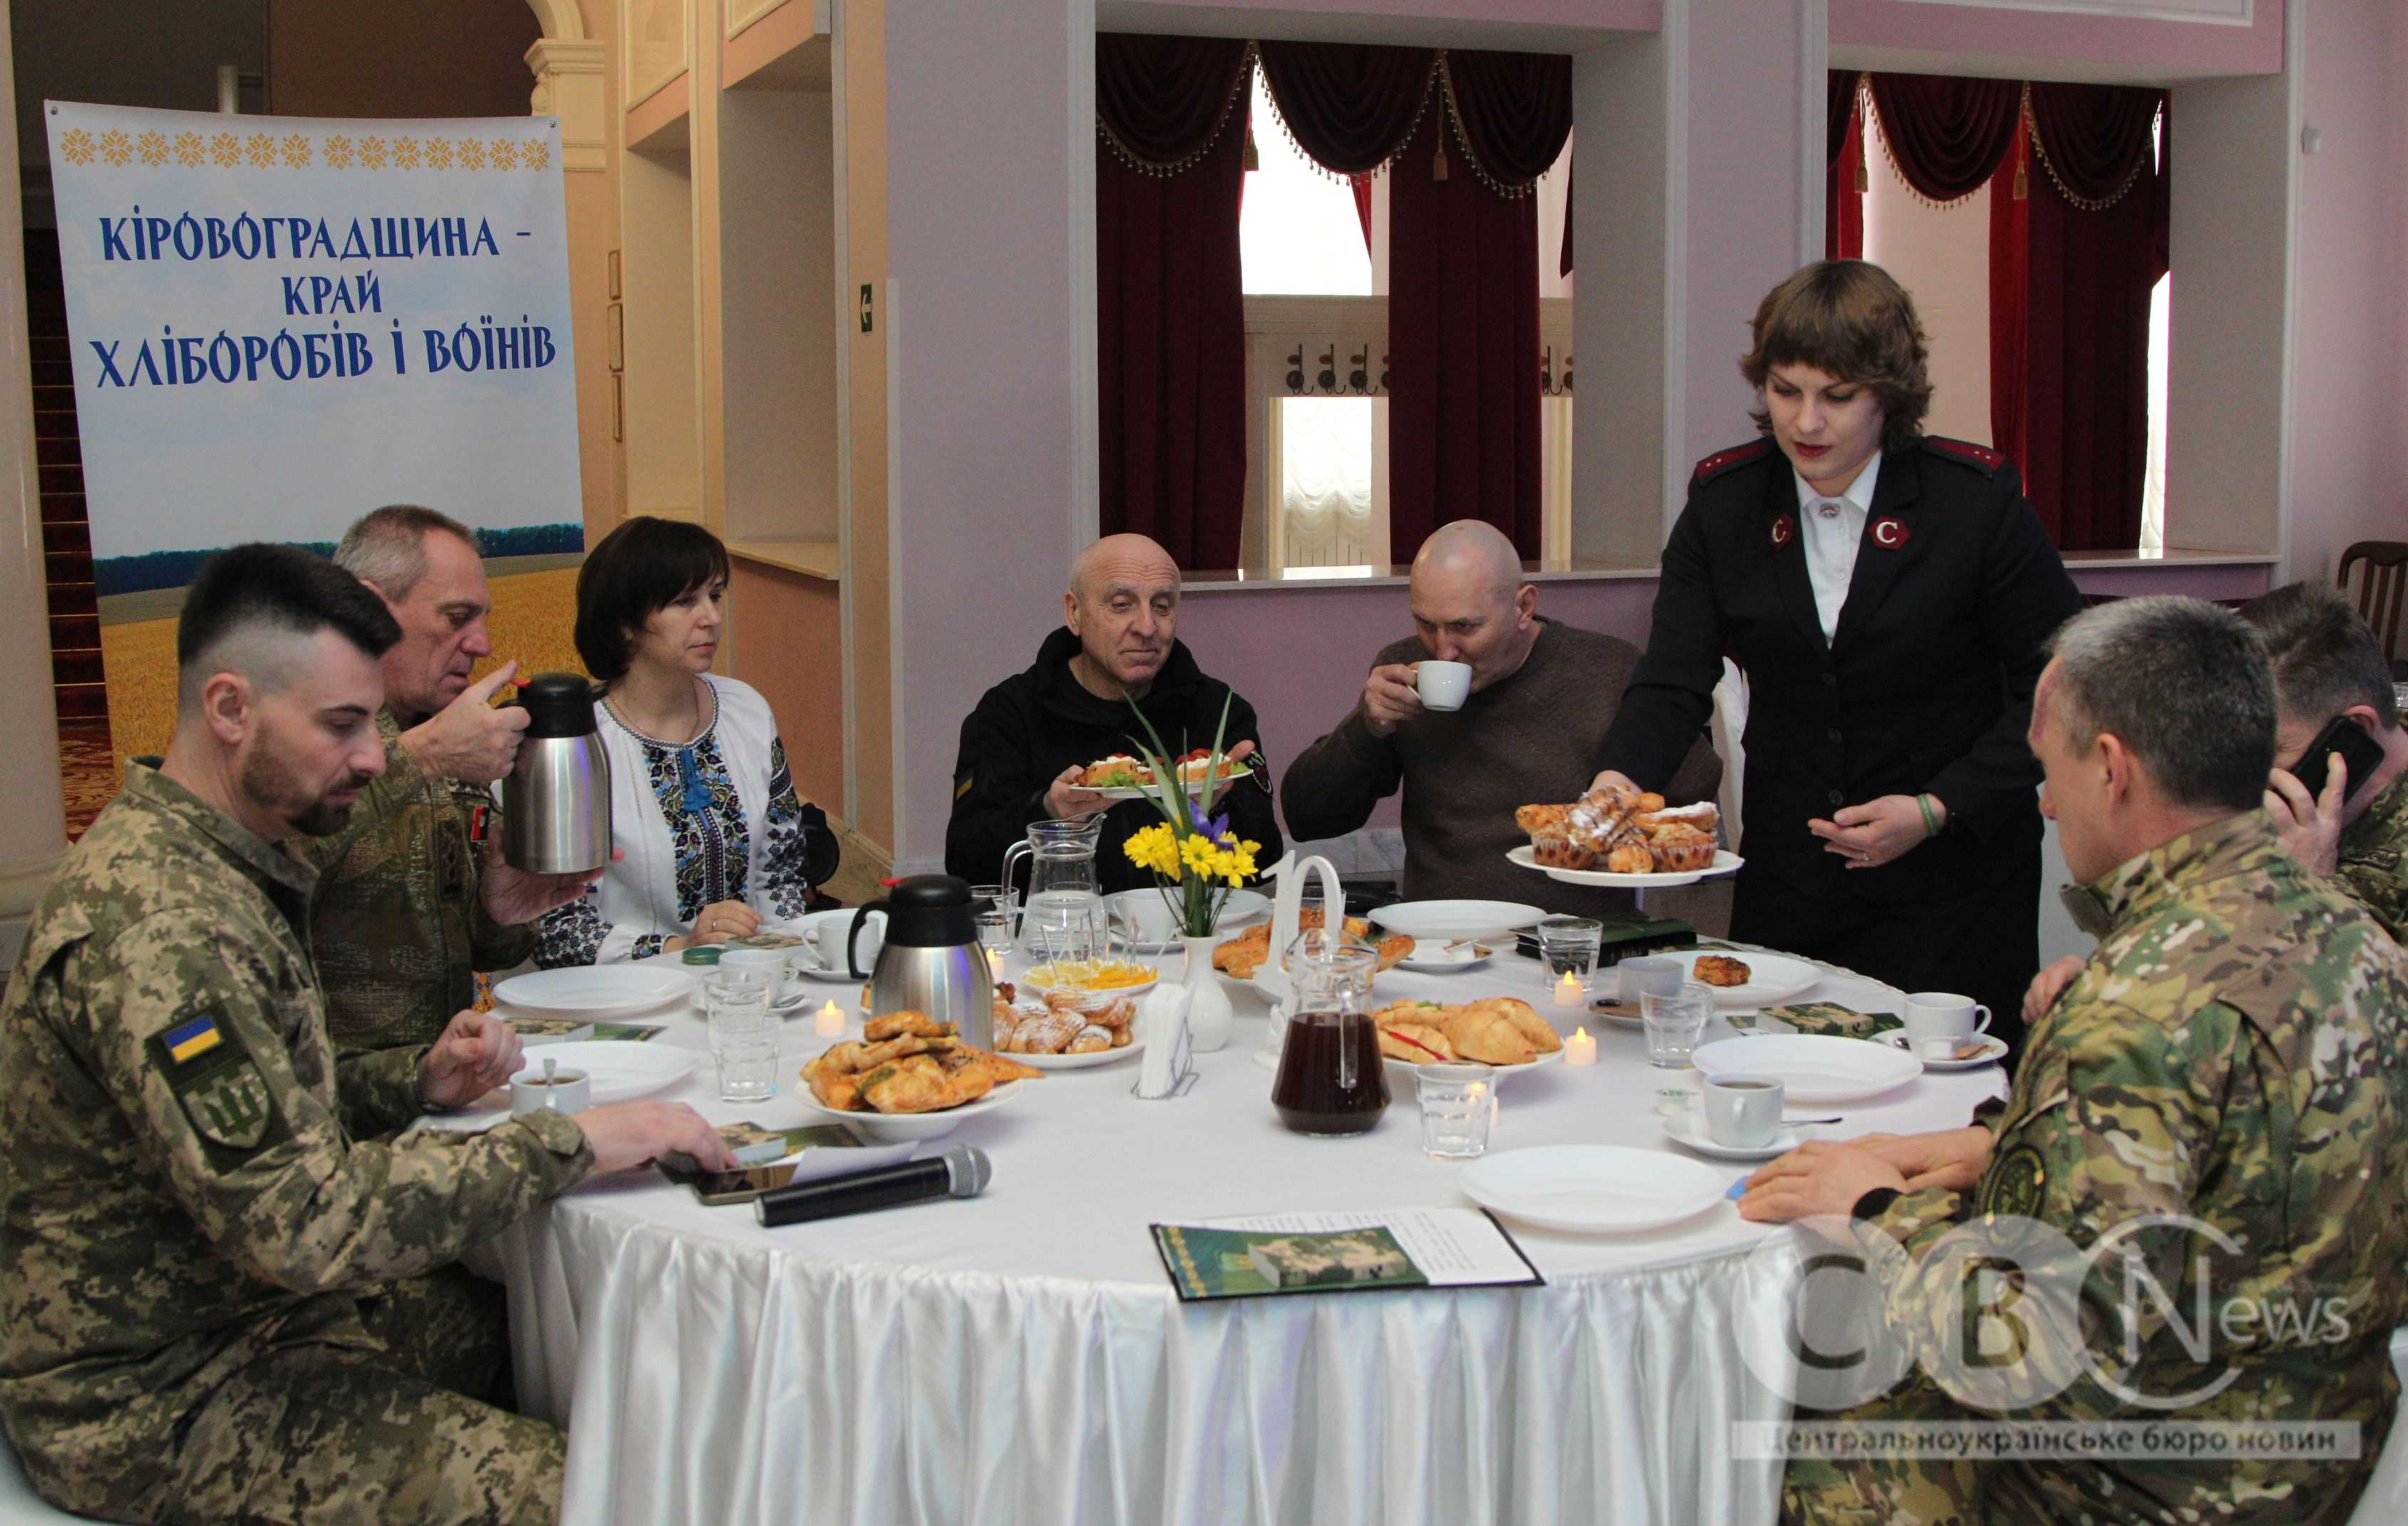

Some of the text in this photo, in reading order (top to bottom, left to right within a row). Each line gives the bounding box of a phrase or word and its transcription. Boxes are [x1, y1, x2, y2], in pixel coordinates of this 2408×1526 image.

[99, 204, 500, 261] КІРОВОГРАДЩИНА
[282, 269, 383, 314] КРАЙ
[90, 319, 374, 388] ХЛІБОРОБІВ
[423, 314, 557, 373] ВОЇНІВ
